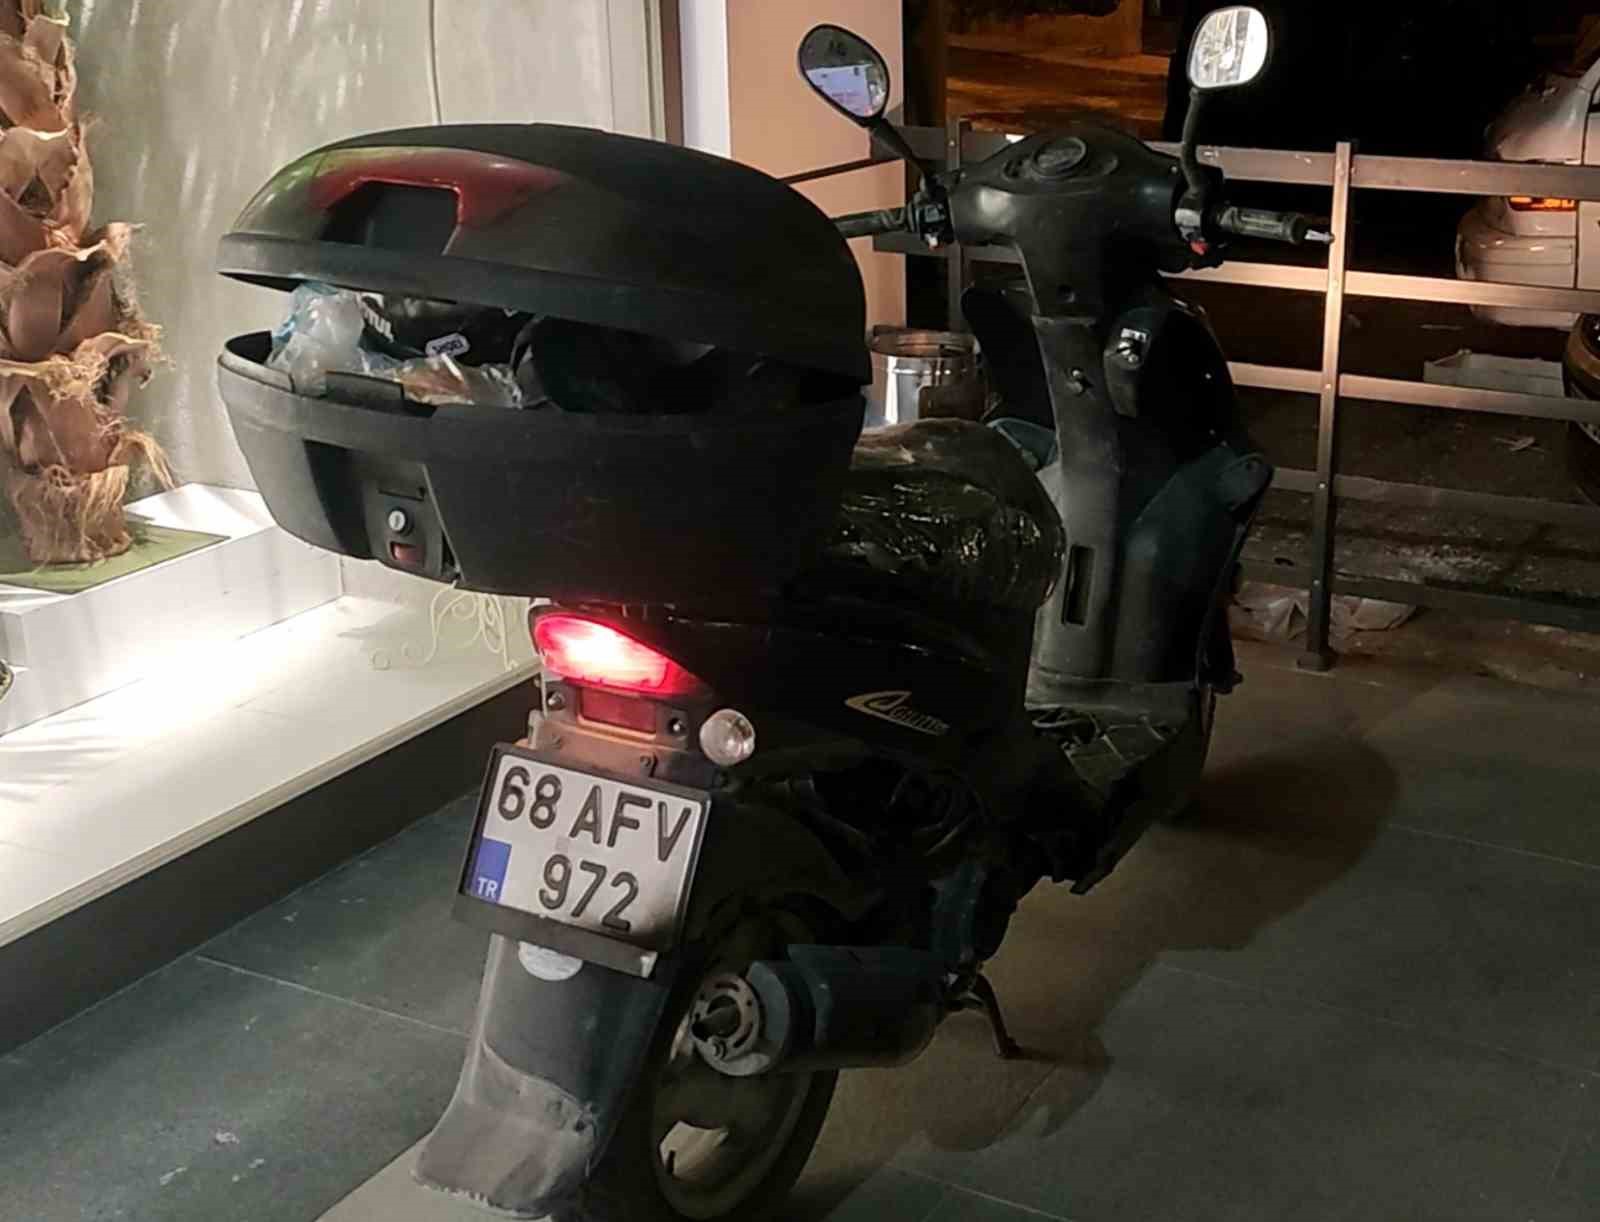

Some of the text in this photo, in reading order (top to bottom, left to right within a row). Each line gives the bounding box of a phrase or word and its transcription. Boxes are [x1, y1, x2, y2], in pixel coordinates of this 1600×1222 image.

[497, 766, 692, 862] 68 AFV
[477, 877, 498, 898] TR
[538, 854, 639, 932] 972
